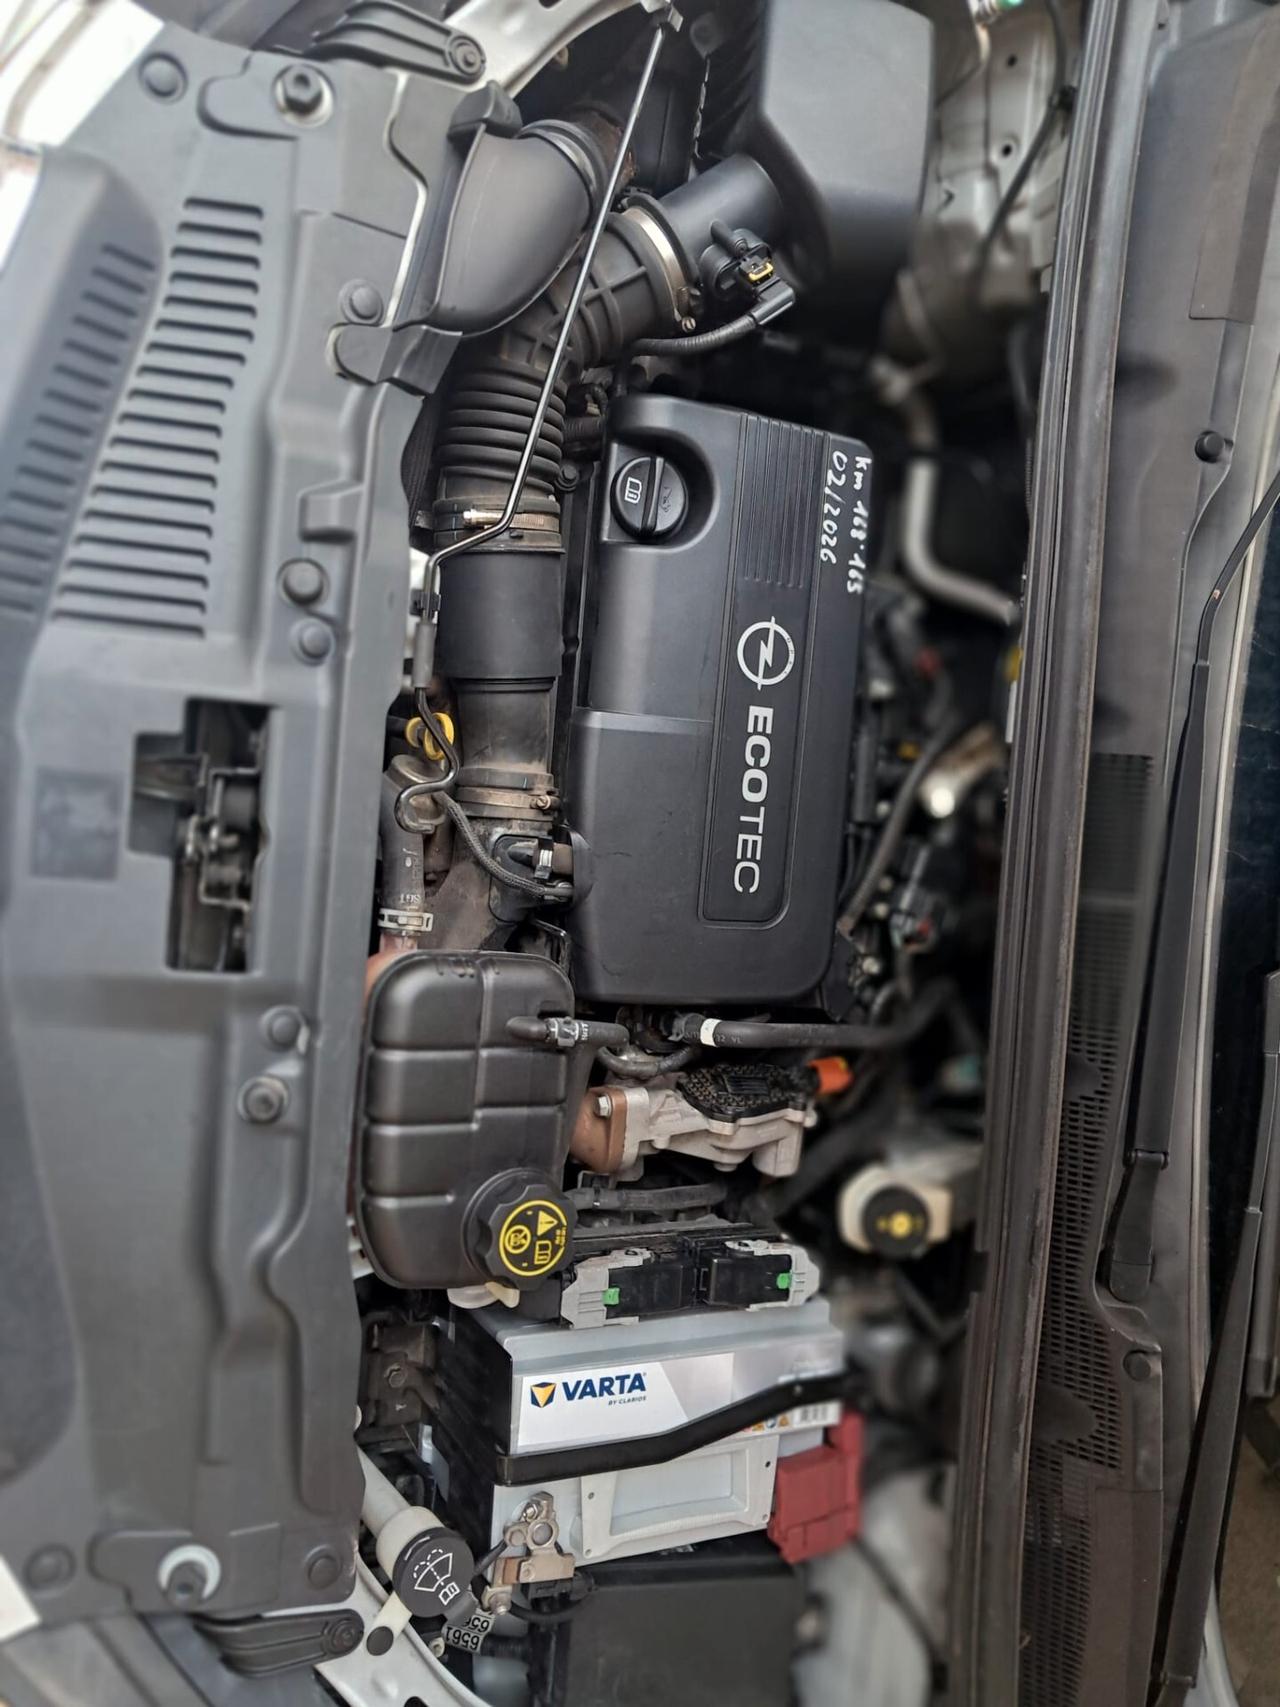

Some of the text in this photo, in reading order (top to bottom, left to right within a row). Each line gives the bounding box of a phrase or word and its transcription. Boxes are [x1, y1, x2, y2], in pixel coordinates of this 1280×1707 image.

[820, 451, 848, 564] 02/2026
[733, 705, 774, 894] ECOTEC
[562, 1372, 646, 1402] VARTA
[619, 1396, 647, 1405] CLARIOS
[445, 1626, 480, 1651] 6561
